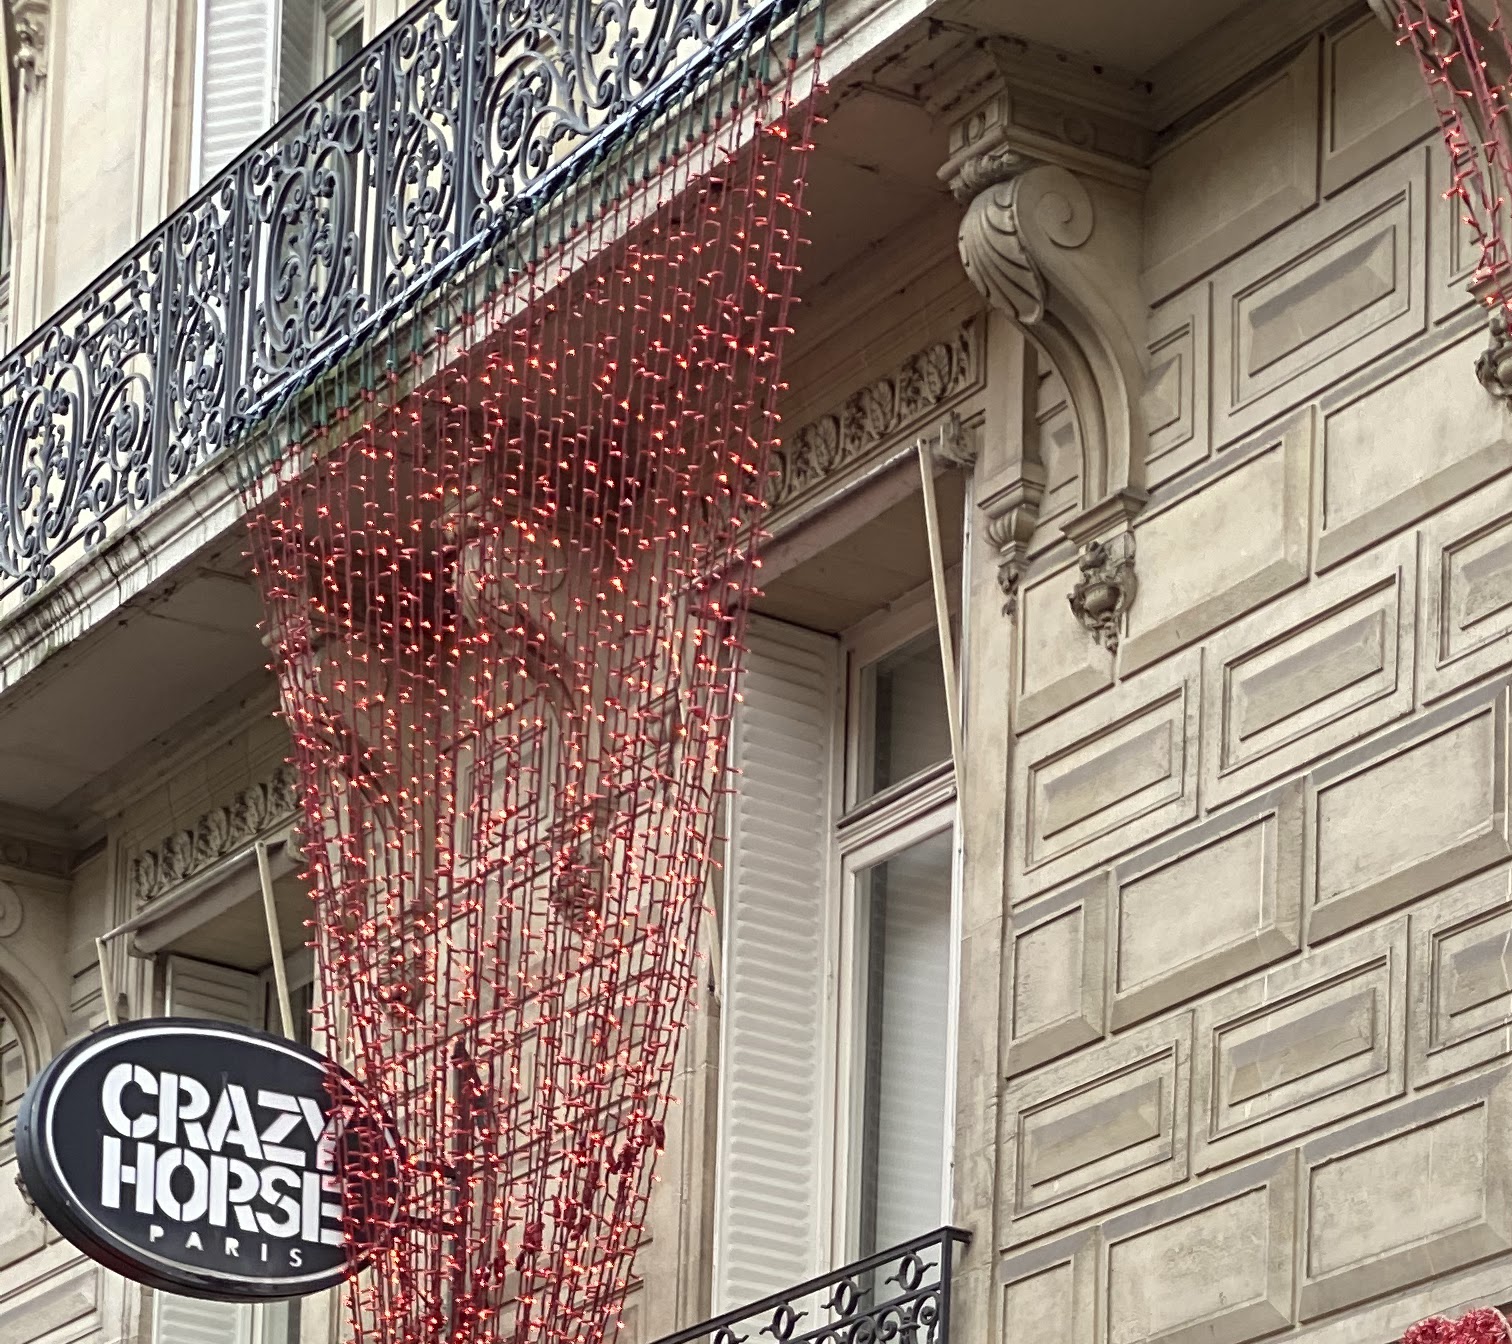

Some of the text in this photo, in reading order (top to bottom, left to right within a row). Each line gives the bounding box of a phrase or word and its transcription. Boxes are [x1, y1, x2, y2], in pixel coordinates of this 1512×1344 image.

[102, 1063, 352, 1171] CRAZY
[102, 1135, 348, 1245] HORSE
[150, 1224, 303, 1267] PARIS
